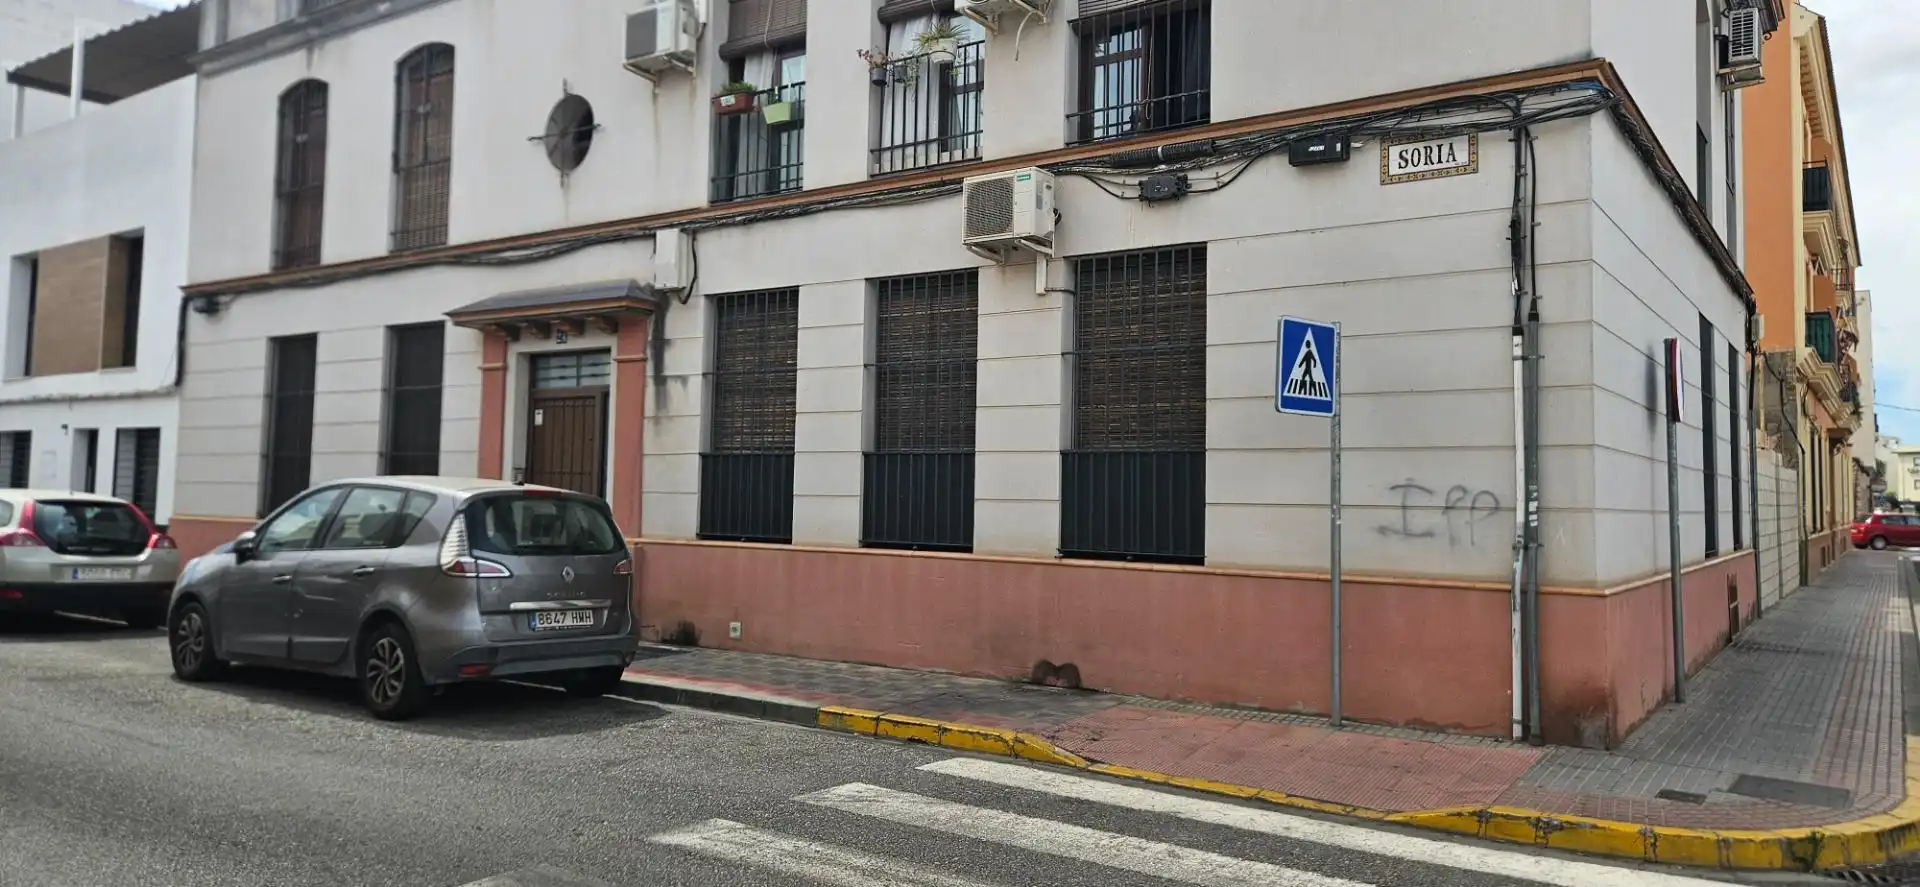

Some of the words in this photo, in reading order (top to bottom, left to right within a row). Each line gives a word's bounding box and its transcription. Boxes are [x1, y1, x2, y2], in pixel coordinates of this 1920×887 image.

[1398, 142, 1457, 170] SORIA
[538, 611, 567, 625] 8647
[571, 611, 592, 622] HMH
